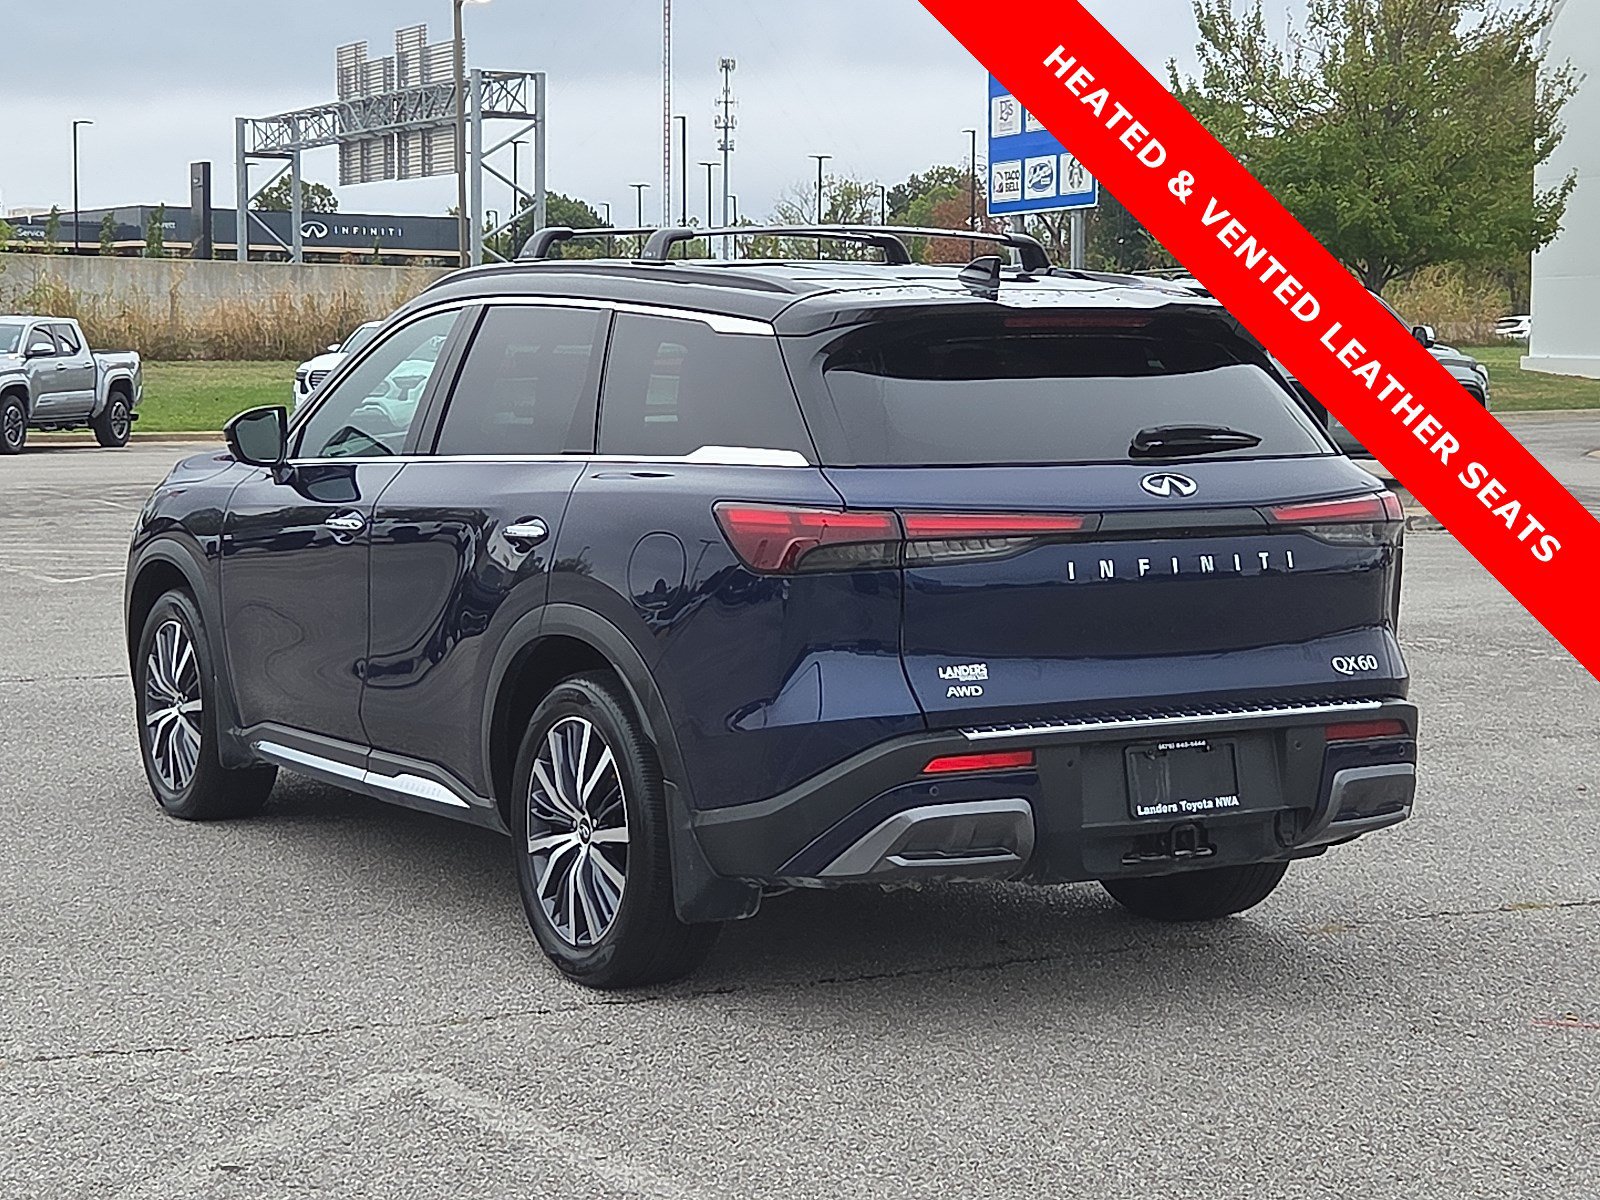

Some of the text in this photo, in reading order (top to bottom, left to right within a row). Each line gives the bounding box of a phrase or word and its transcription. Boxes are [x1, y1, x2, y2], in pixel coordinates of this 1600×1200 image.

[1004, 169, 1020, 180] TACO
[17, 226, 46, 238] Service
[333, 225, 404, 238] INFINITI
[1068, 551, 1295, 580] INFINITI
[938, 663, 987, 679] LANDERS
[1331, 654, 1379, 676] QX60
[946, 685, 983, 698] AWD
[1136, 794, 1240, 815] Landers Toyota NWA
